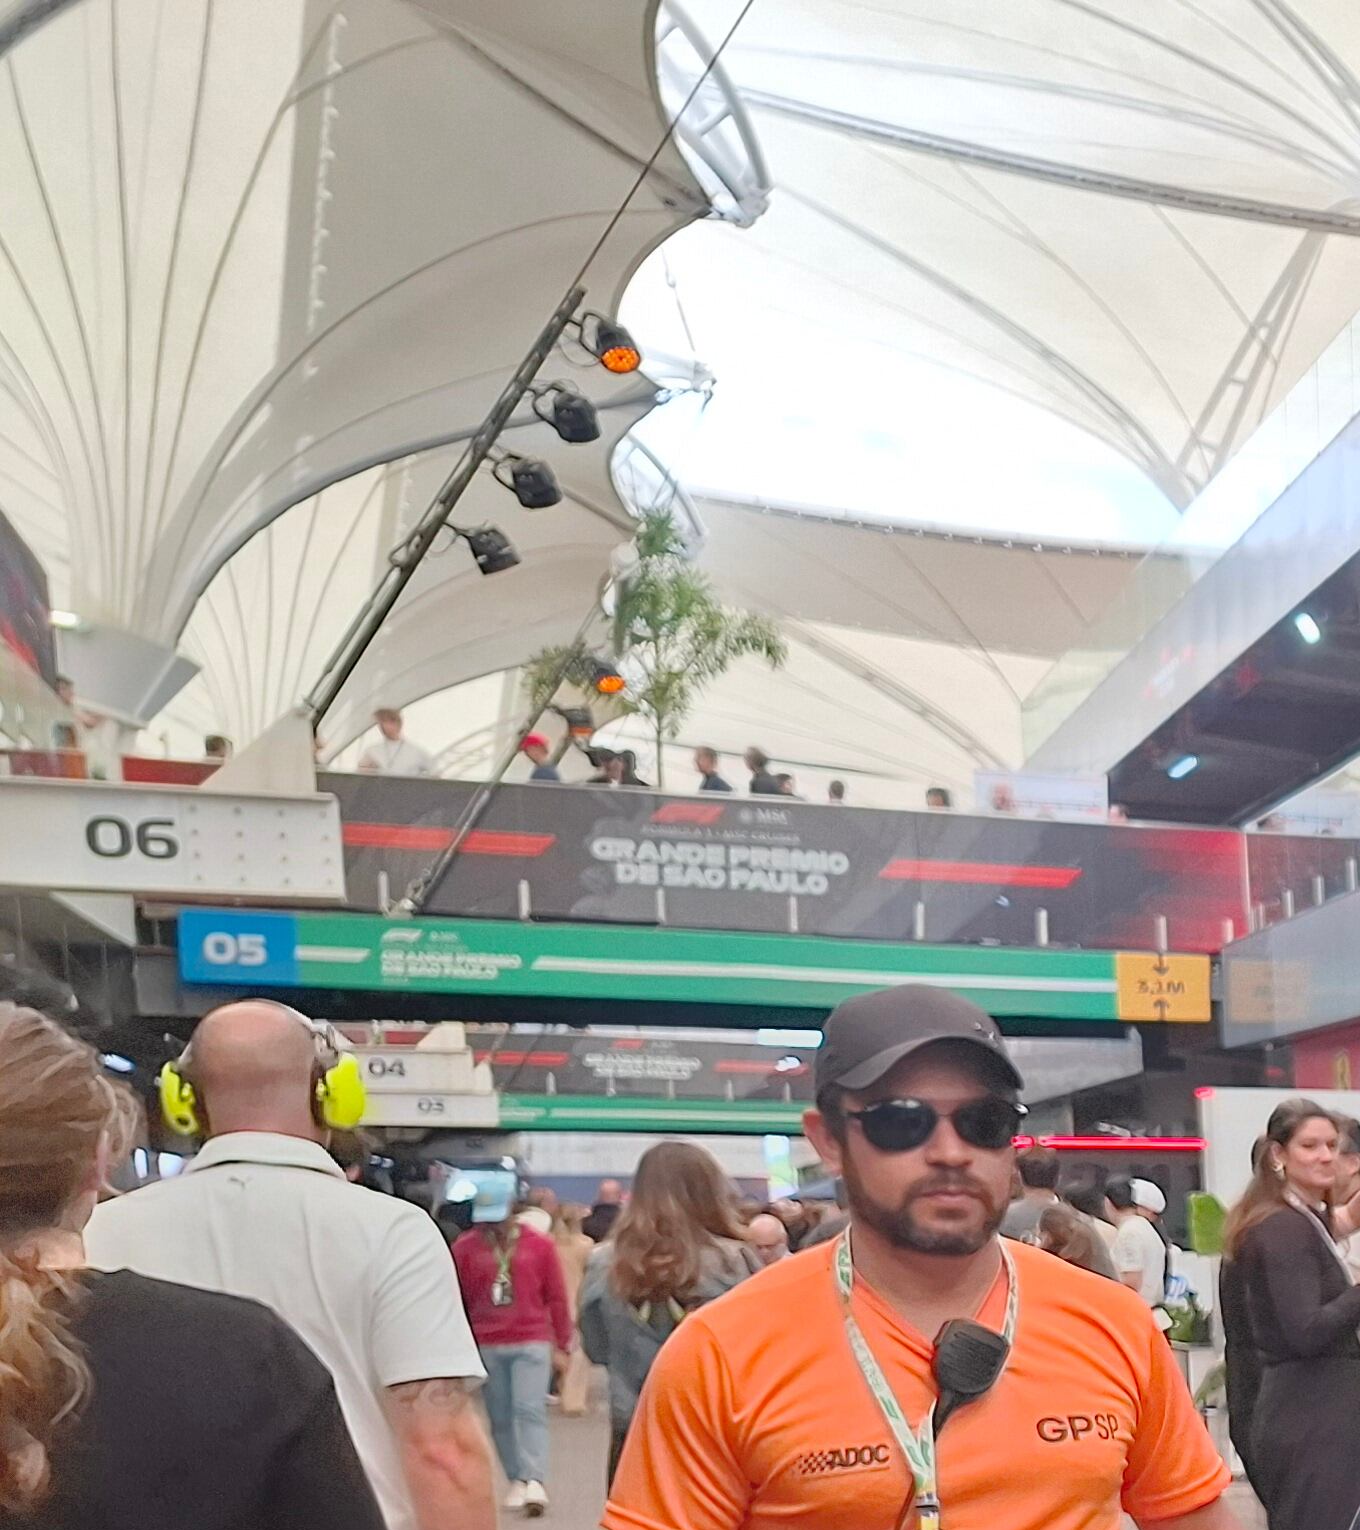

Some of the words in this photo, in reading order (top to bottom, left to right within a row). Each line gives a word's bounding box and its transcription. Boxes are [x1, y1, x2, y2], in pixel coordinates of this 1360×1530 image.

[84, 814, 180, 859] 06
[202, 931, 268, 966] 05
[367, 1056, 406, 1079] 04
